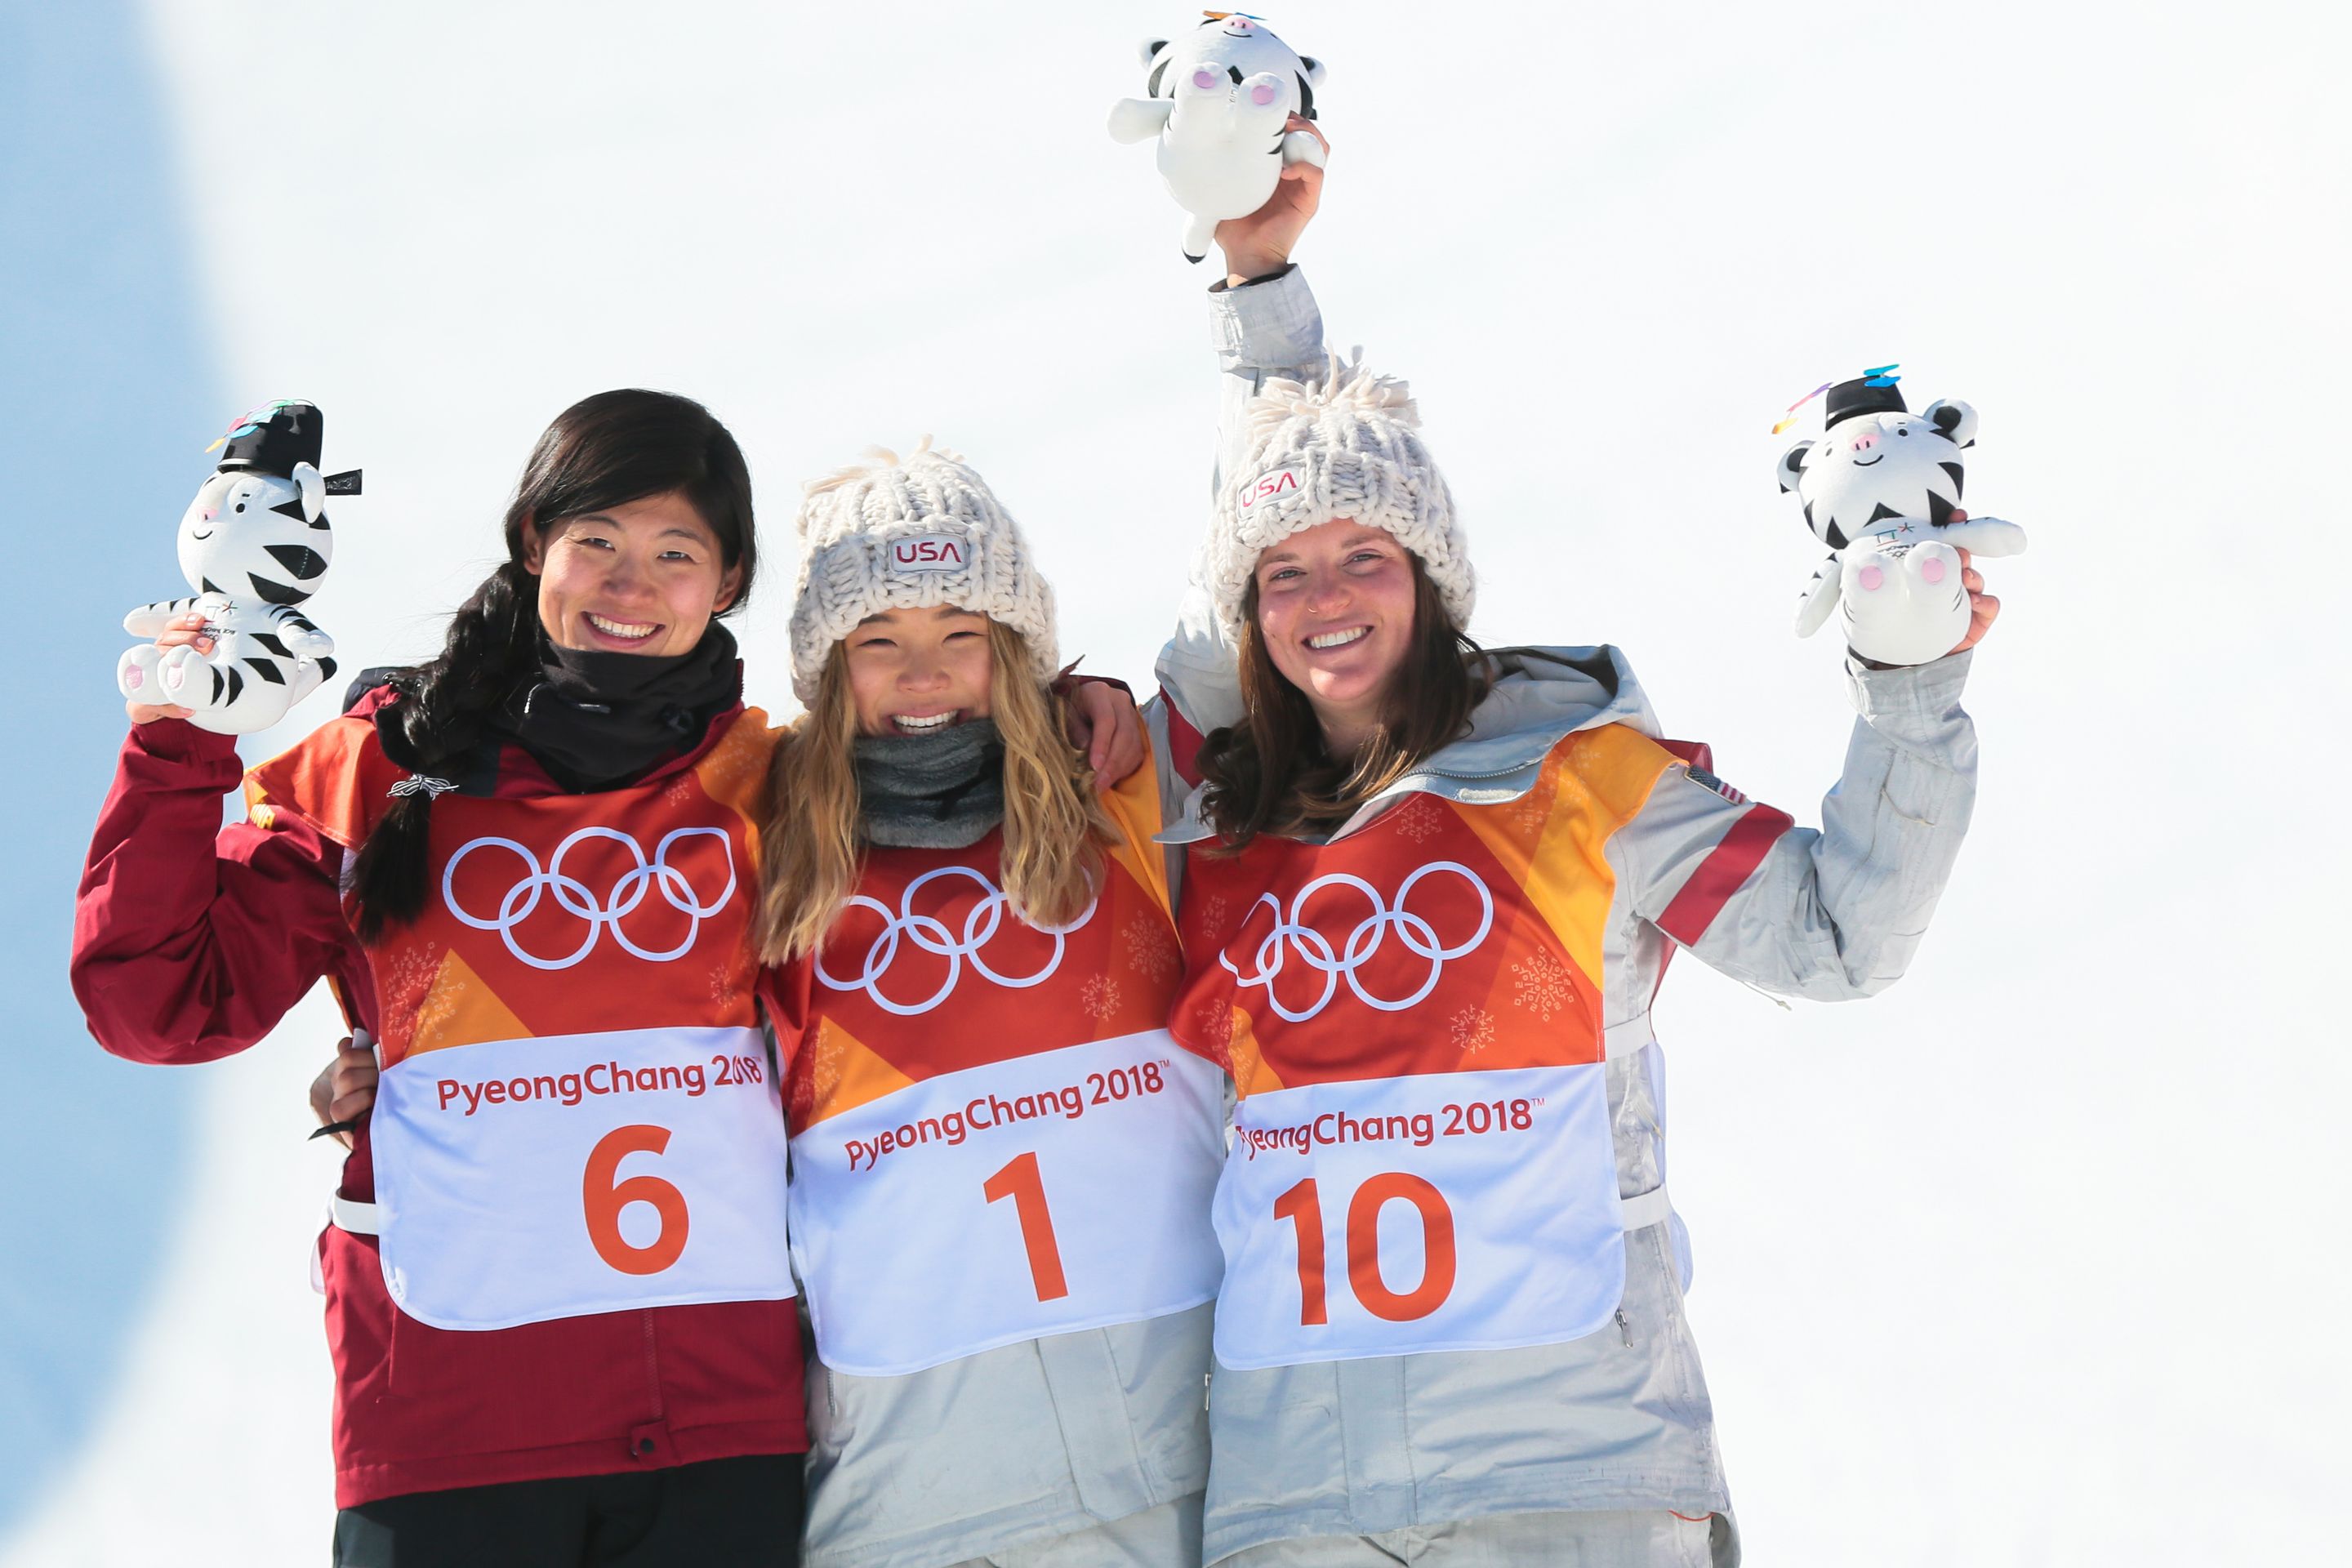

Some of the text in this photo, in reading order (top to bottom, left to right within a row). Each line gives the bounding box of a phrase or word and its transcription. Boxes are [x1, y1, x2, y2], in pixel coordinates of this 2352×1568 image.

[1242, 472, 1297, 507] USA
[896, 541, 962, 564] USA
[437, 1062, 706, 1116] PyeongChang
[844, 1086, 1084, 1171] PyeongChang
[583, 1125, 690, 1276] 6
[983, 1152, 1068, 1303] 1
[1274, 1172, 1457, 1326] 10
